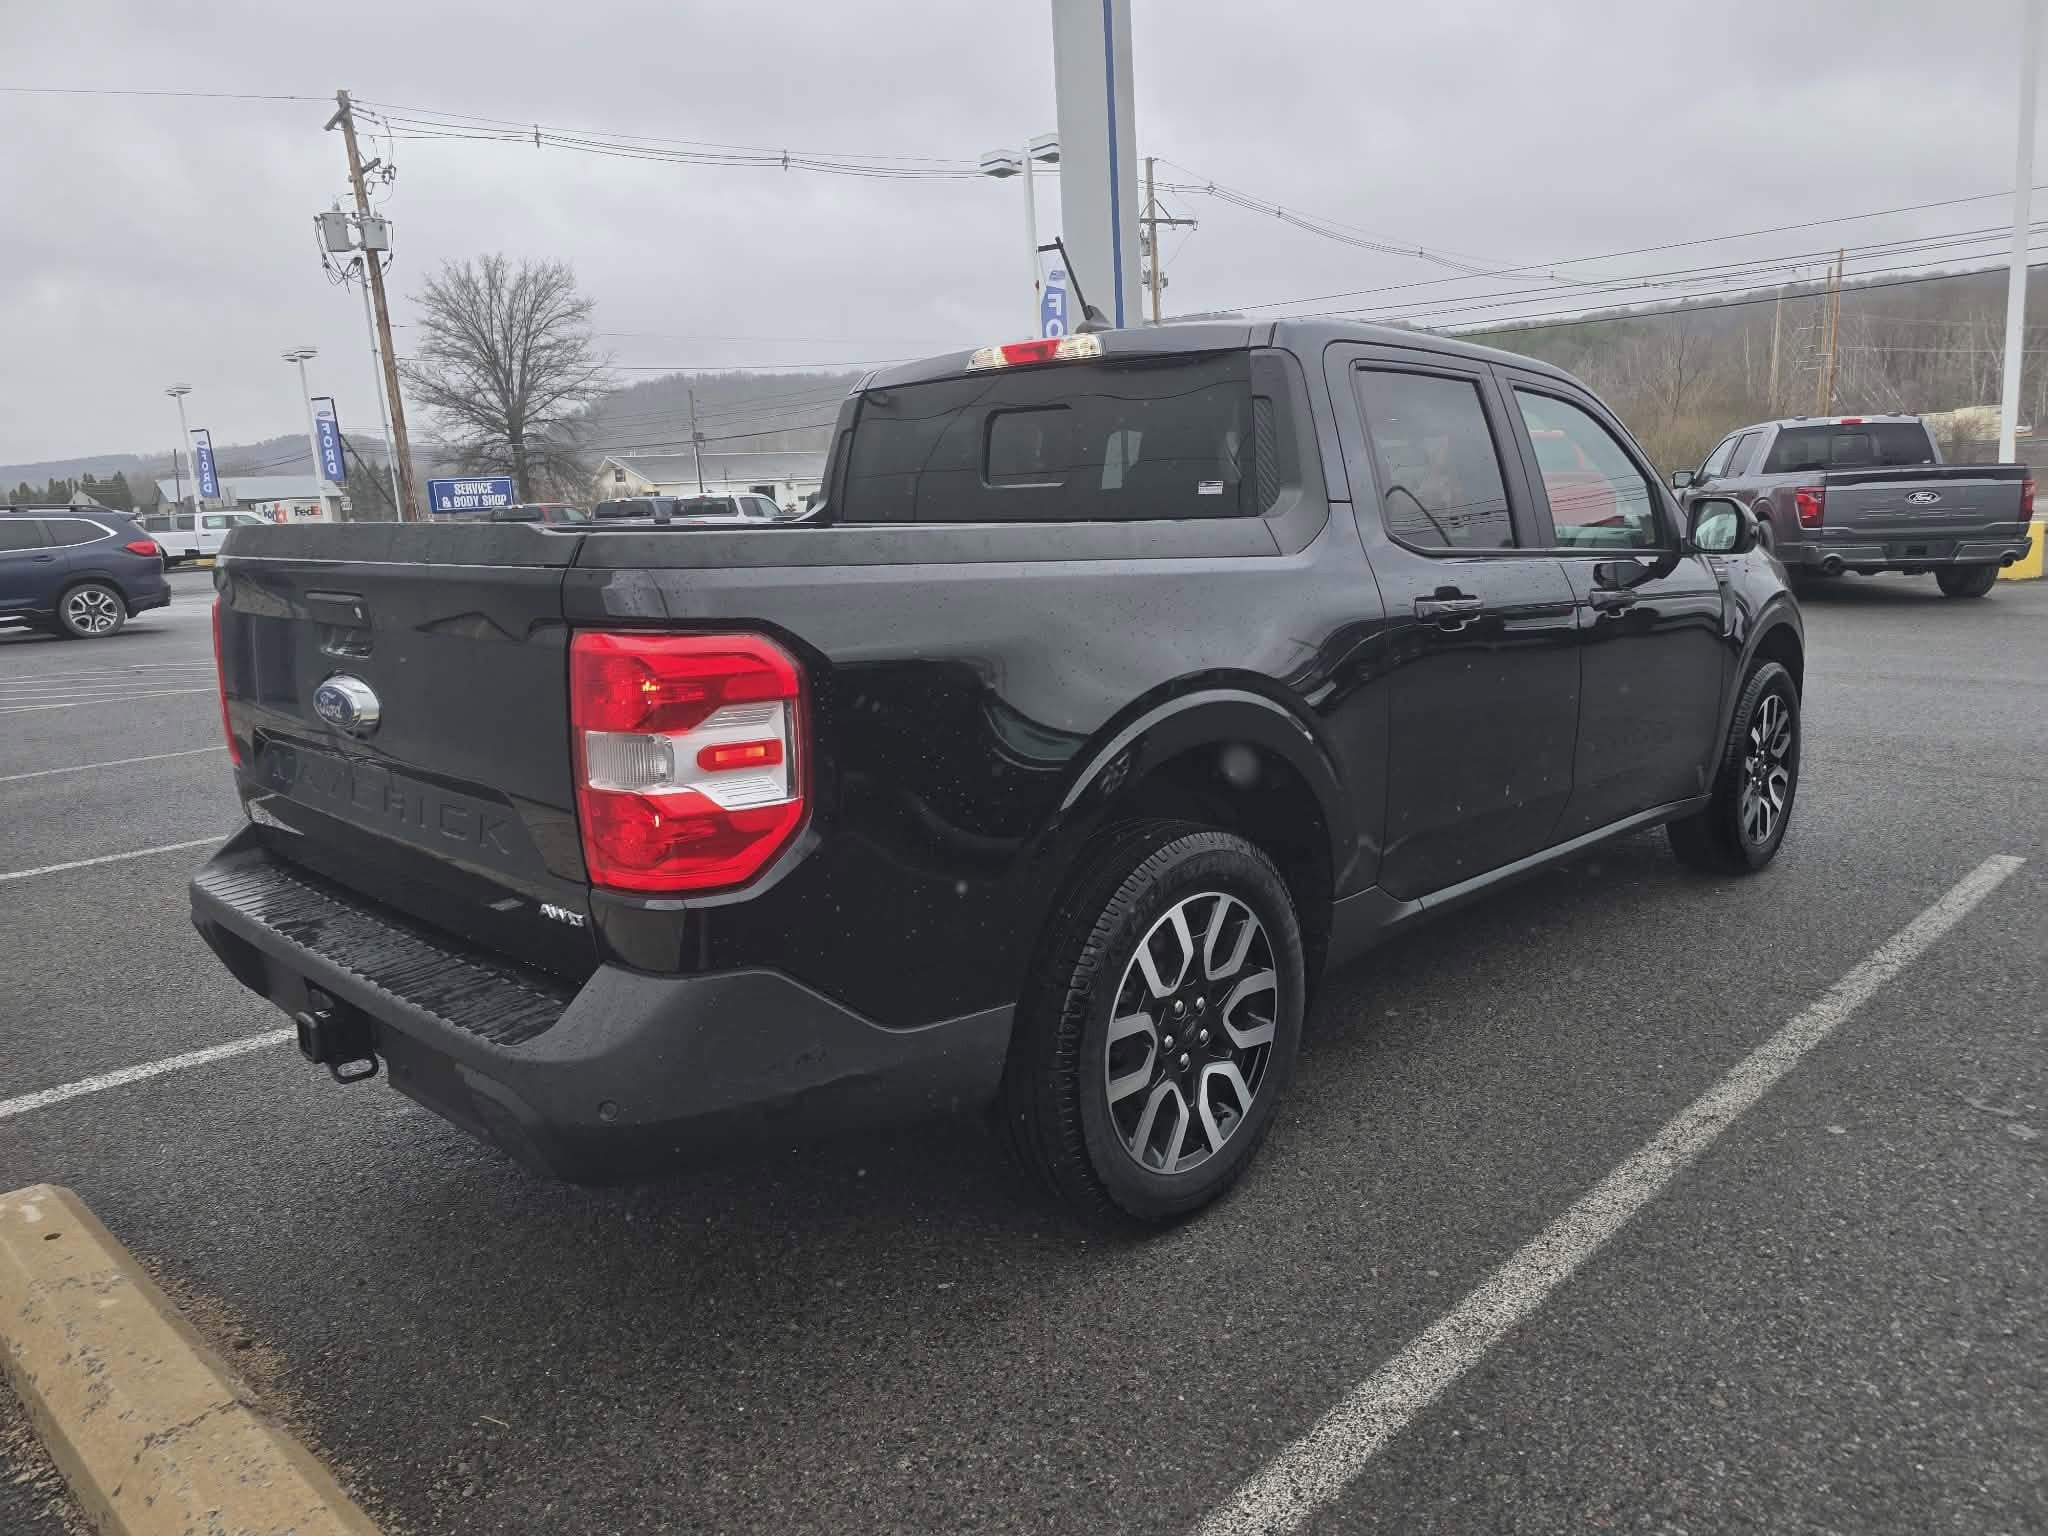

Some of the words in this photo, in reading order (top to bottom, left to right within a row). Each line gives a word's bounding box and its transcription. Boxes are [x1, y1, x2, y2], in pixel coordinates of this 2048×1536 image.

[454, 482, 494, 495] SERVICE
[442, 497, 452, 508] &
[453, 495, 479, 508] BODY
[481, 494, 507, 506] SHOP
[294, 505, 321, 517] FedE
[319, 691, 343, 720] Ford
